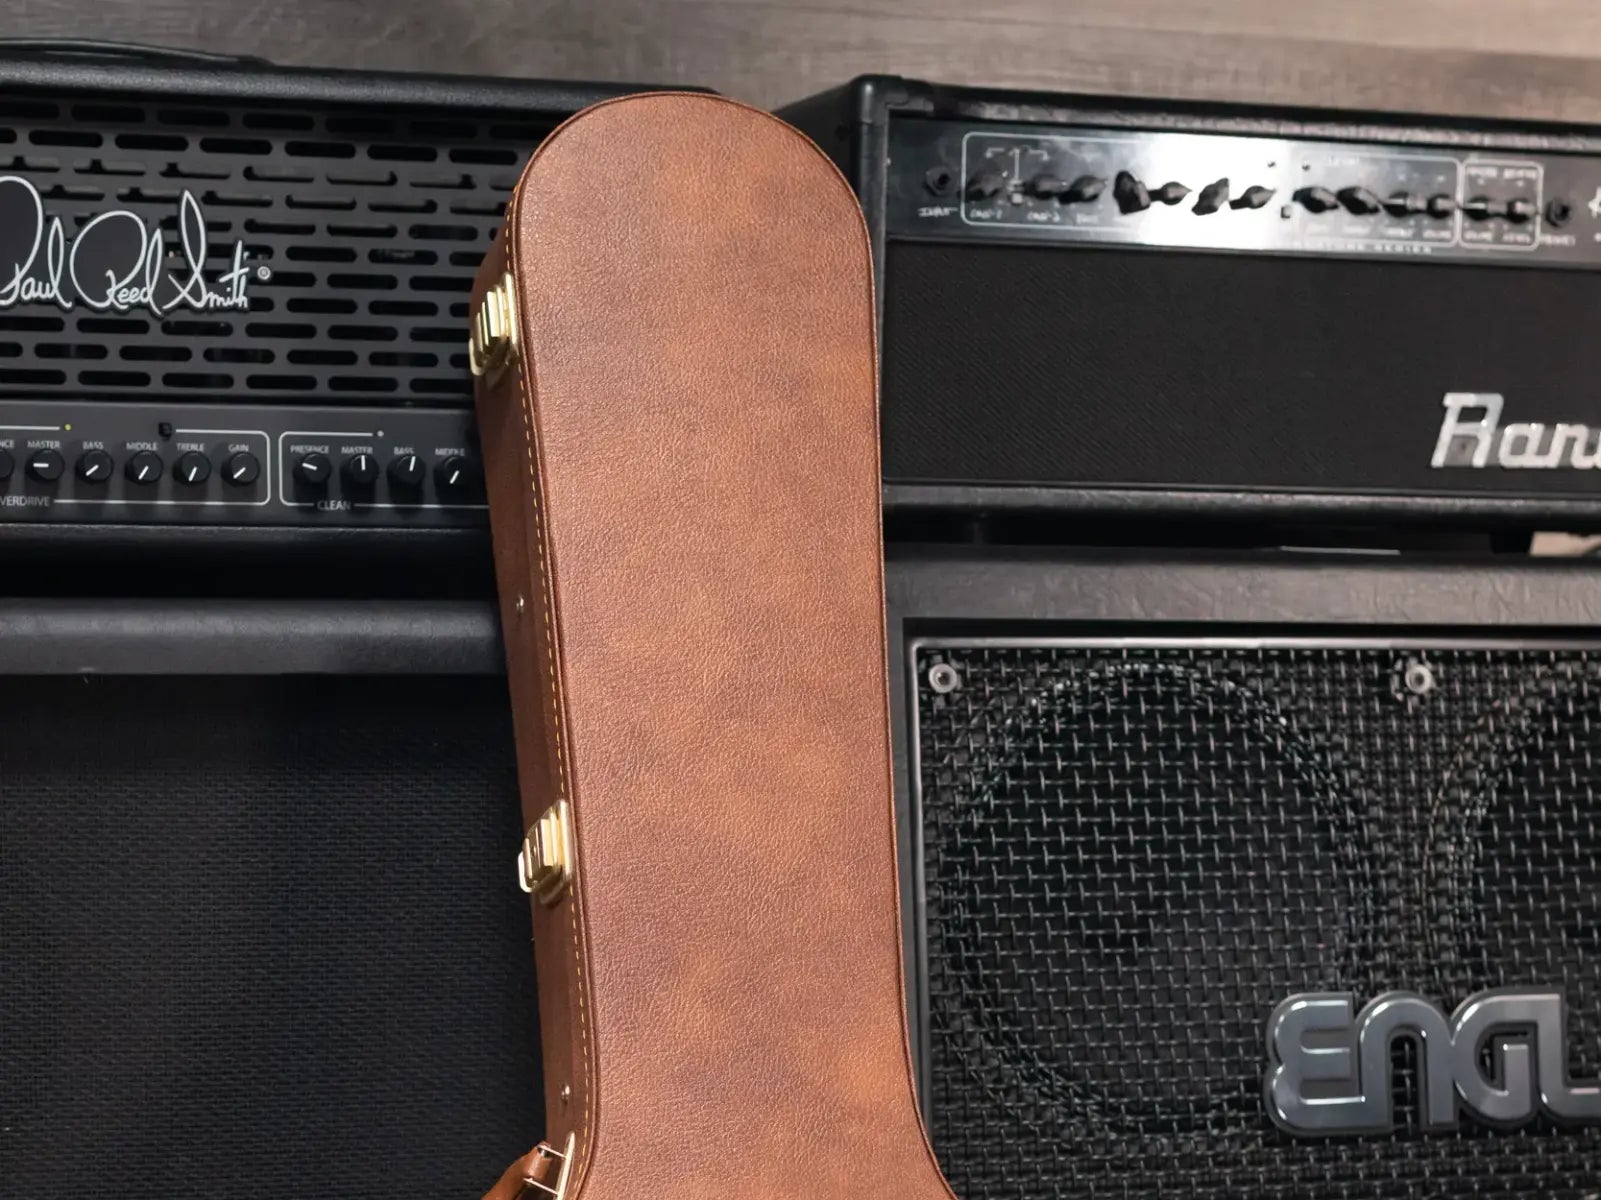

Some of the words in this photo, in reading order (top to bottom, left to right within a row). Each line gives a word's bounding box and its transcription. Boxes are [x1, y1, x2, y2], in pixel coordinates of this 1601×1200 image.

[69, 210, 162, 315] Reed
[162, 189, 250, 309] Smith
[1430, 392, 1601, 469] Ran
[27, 439, 61, 449] MASTER
[82, 440, 104, 450] BASS
[126, 441, 158, 451] MIDDLE
[176, 442, 204, 452] TREBLE
[228, 443, 250, 453] GAIN
[290, 444, 329, 454] PRESENCE
[341, 445, 373, 455] MASTER
[393, 446, 415, 455] BASS
[434, 447, 466, 456] MIDDLE
[0, 496, 50, 507] VERDRIVE
[317, 500, 351, 511] CLEAN
